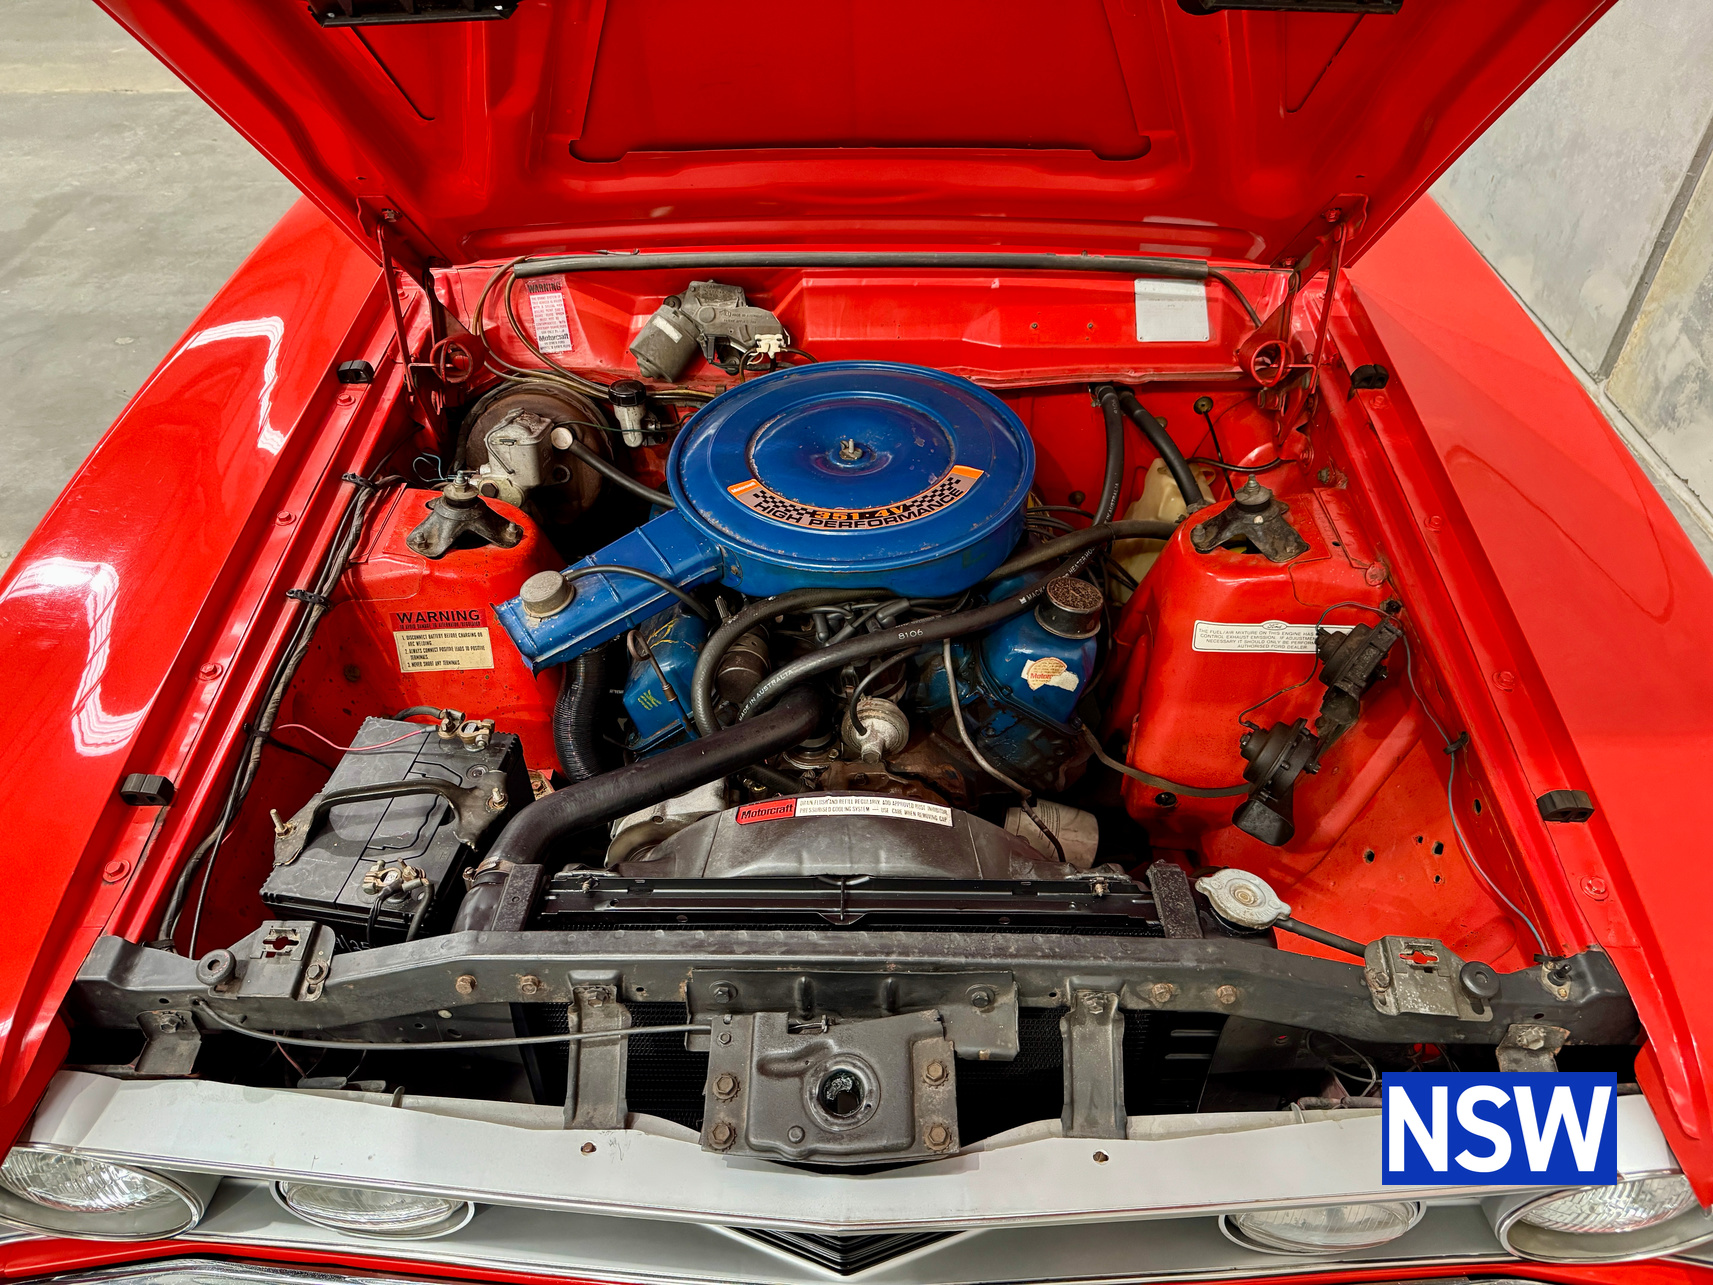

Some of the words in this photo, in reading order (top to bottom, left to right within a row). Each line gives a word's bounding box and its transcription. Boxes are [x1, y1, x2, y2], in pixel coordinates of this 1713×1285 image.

[528, 282, 561, 293] WARNING
[539, 333, 568, 341] Motorcraft
[754, 501, 802, 523] HIGH
[809, 487, 963, 528] PERFORMANCE
[396, 609, 480, 623] WARNING
[898, 628, 923, 640] 8106
[739, 704, 750, 721] MADE
[756, 669, 793, 698] AUSTRALIA
[892, 800, 914, 808] APPROVED
[741, 804, 793, 819] Motorcraft
